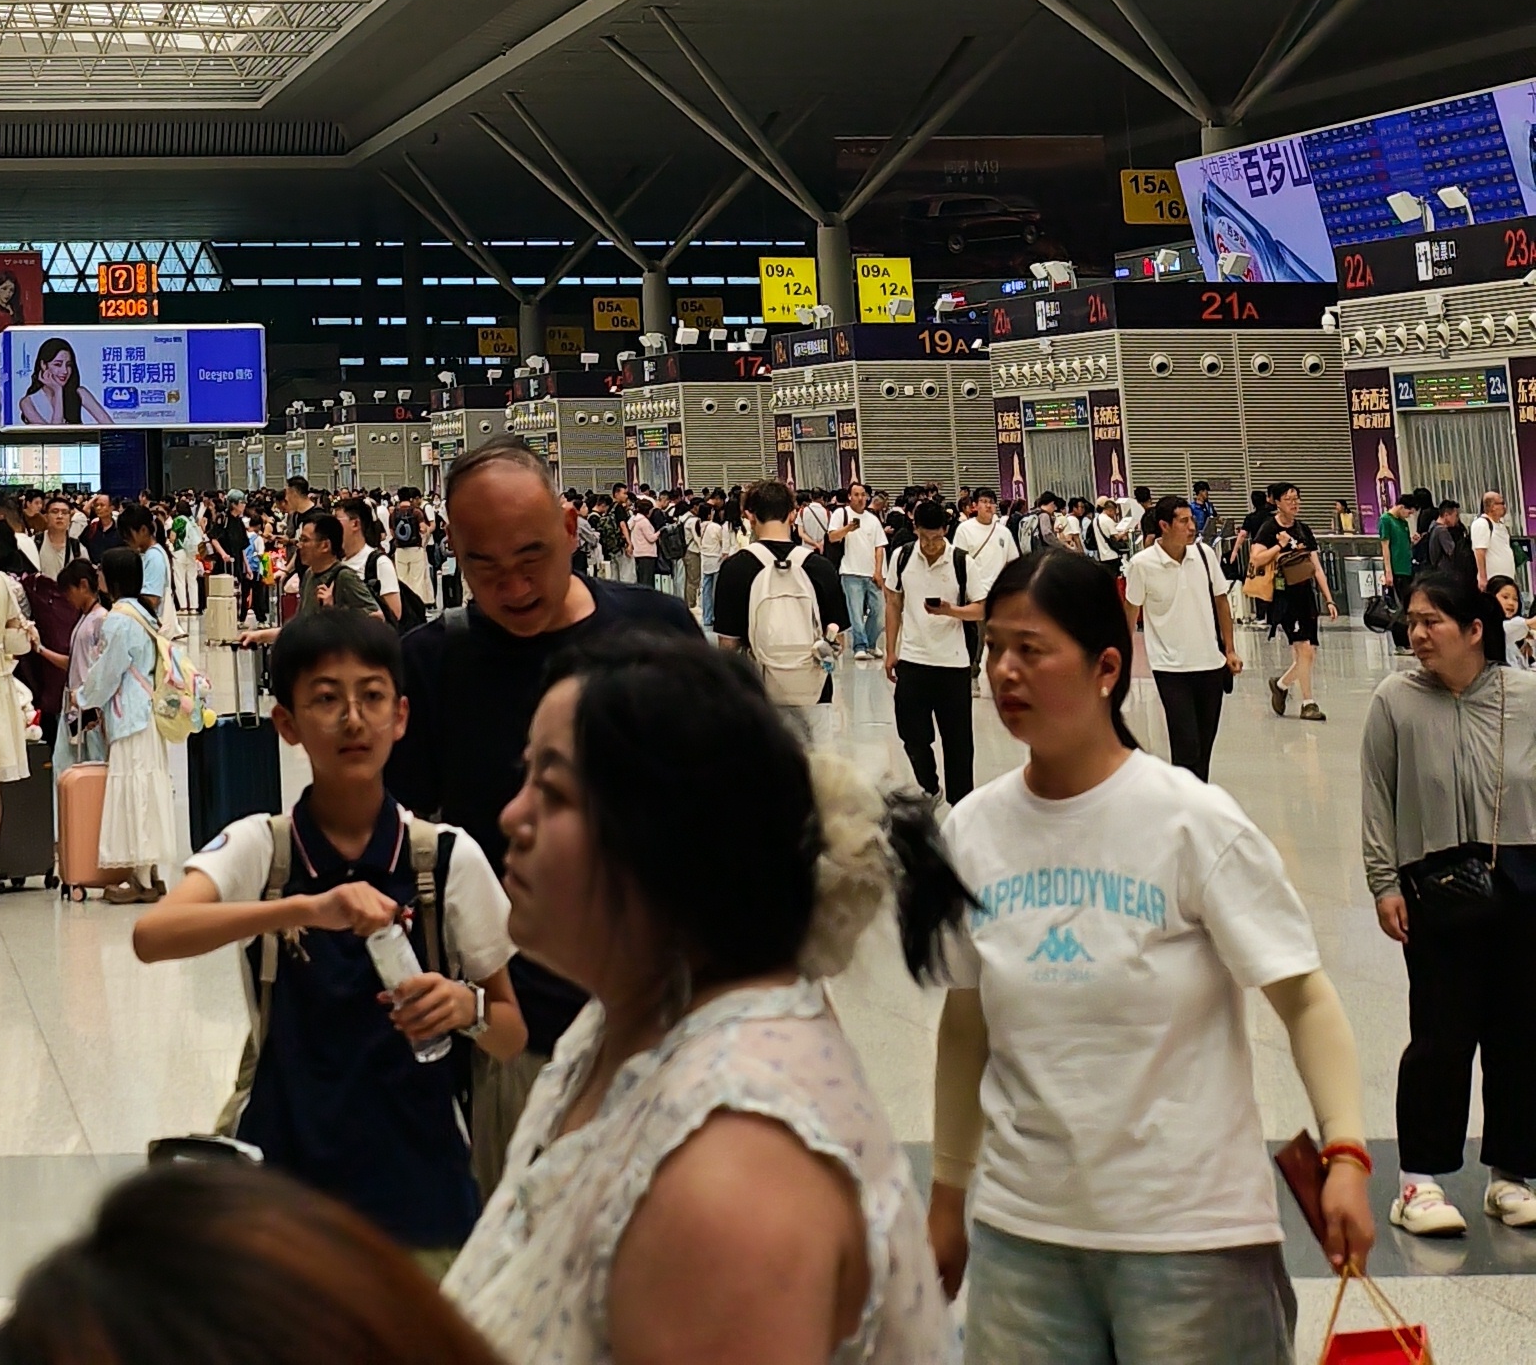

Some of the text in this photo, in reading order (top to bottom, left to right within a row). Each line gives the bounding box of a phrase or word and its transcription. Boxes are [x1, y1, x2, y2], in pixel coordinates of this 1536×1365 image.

[974, 159, 999, 174] M9
[1200, 139, 1313, 199] 水中贵族 百岁山
[1128, 174, 1171, 195] 15A
[1431, 240, 1457, 262] 检票口
[1505, 229, 1536, 267] 23A
[765, 263, 795, 278] 09A
[861, 263, 891, 278] 09A
[1344, 253, 1374, 289] 22A
[783, 282, 813, 296] 12A
[879, 282, 909, 296] 12A
[99, 298, 148, 317] 12306
[597, 300, 623, 313] 05A
[680, 300, 705, 313] 05A
[1088, 294, 1108, 323] 21A
[1201, 291, 1260, 320] 21A
[612, 315, 638, 328] 06A
[480, 330, 503, 340] 01A
[918, 329, 970, 354] 19A
[102, 346, 123, 362] 好用
[493, 342, 514, 353] 02A
[102, 362, 176, 384] 我们都爱用
[1398, 382, 1414, 400] 22A
[1489, 376, 1506, 395] 23A
[1351, 387, 1390, 412] 东奔西走
